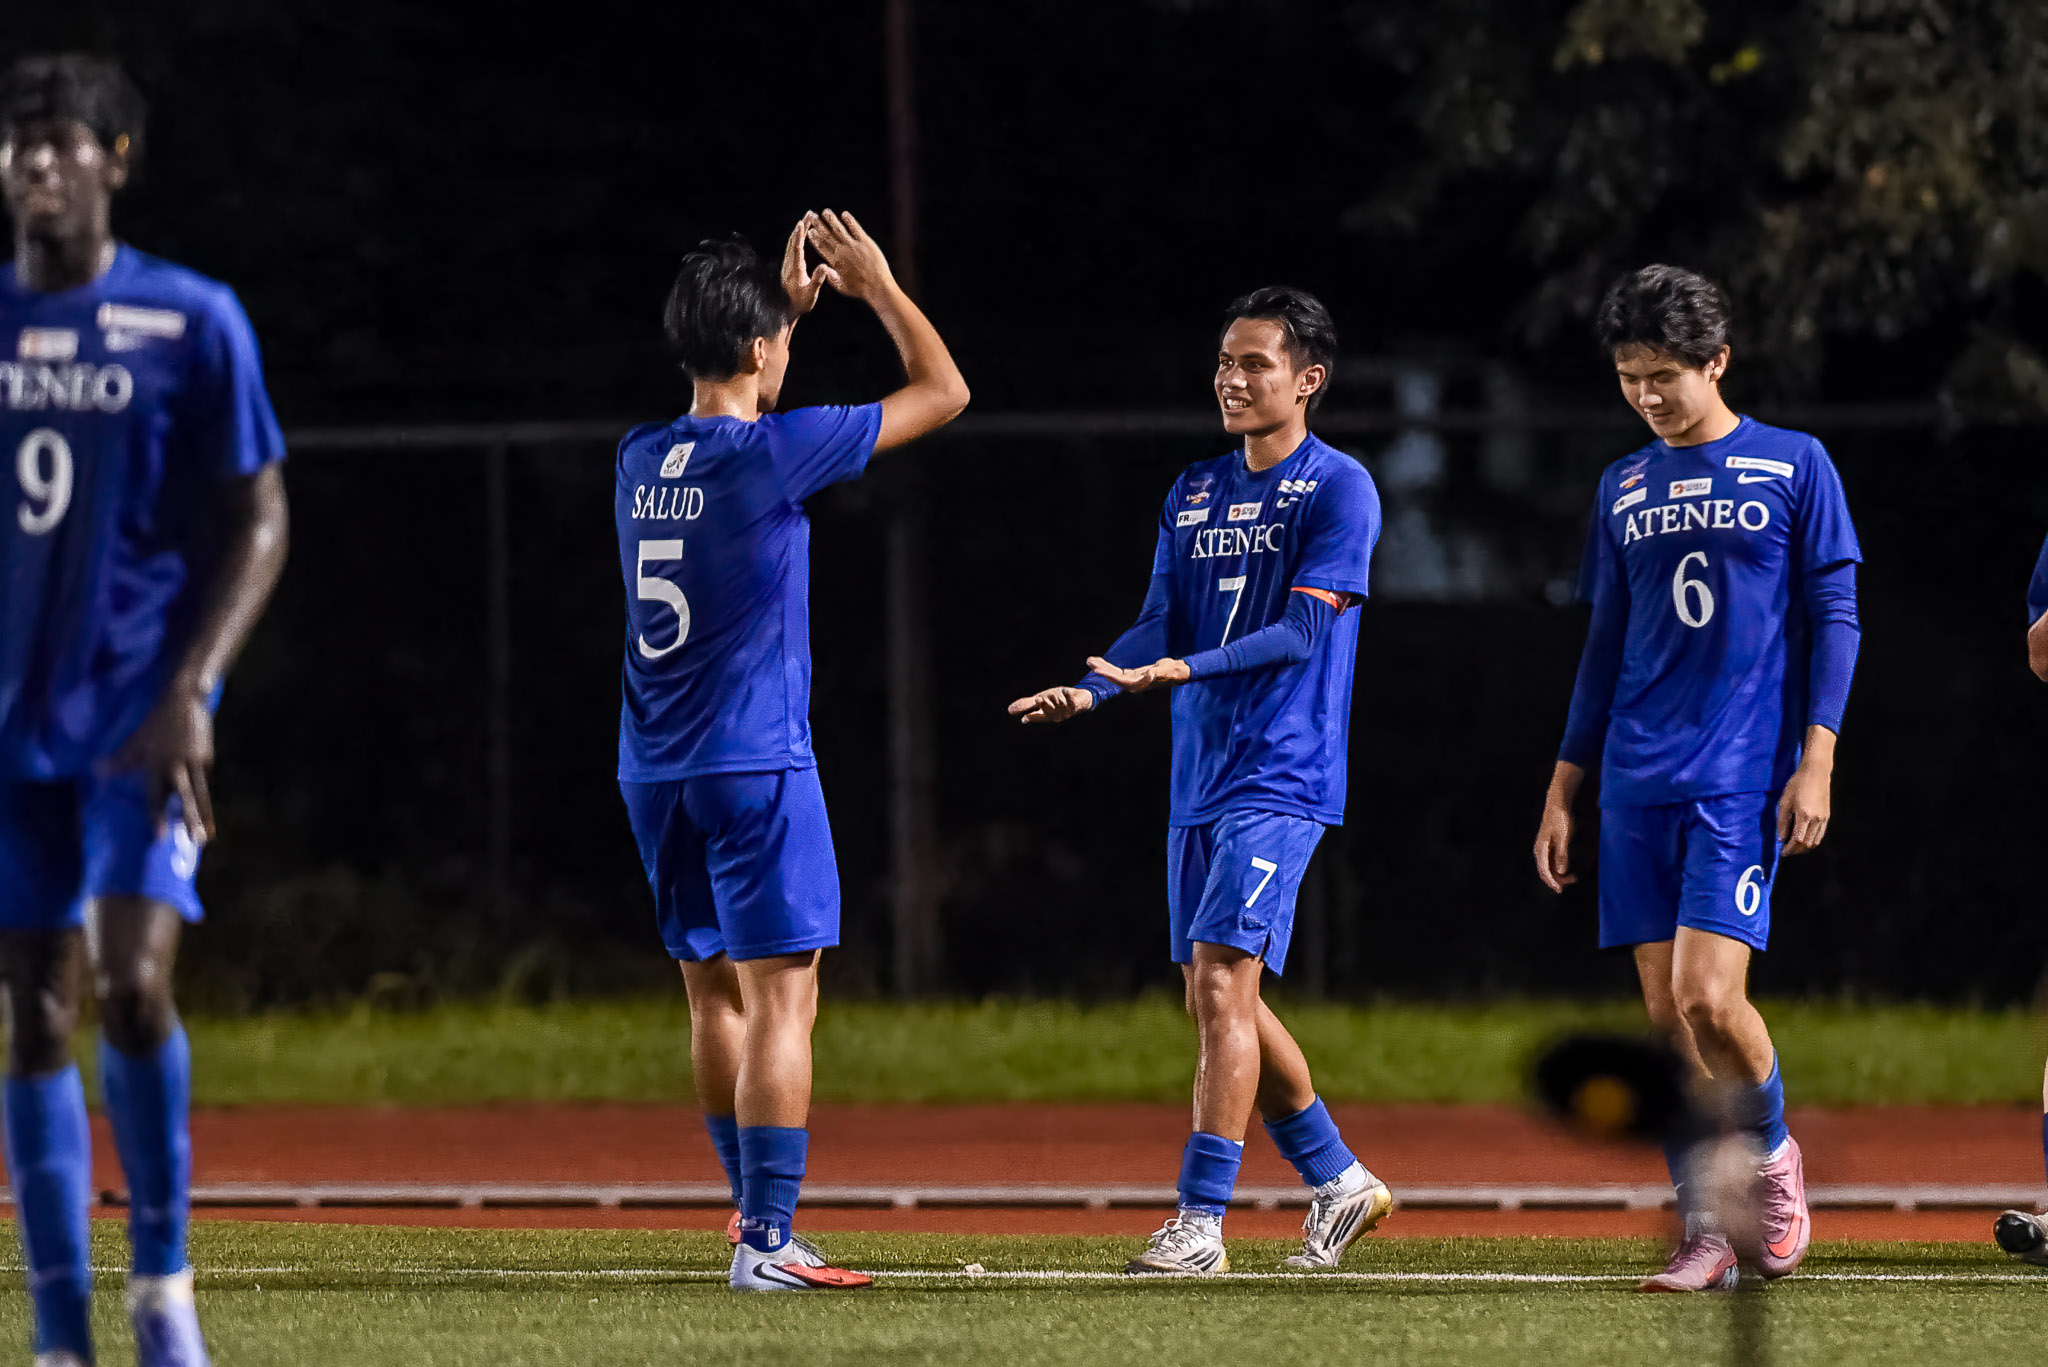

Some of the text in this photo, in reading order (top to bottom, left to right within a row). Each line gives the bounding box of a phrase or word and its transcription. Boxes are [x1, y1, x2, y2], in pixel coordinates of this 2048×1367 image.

[16, 427, 74, 536] 9
[632, 485, 704, 520] SALUD
[1624, 500, 1770, 545] ATENEO
[637, 539, 691, 659] 5
[1219, 575, 1247, 648] 7
[1673, 551, 1715, 628] 6
[1245, 856, 1278, 909] 7
[1735, 864, 1764, 916] 6
